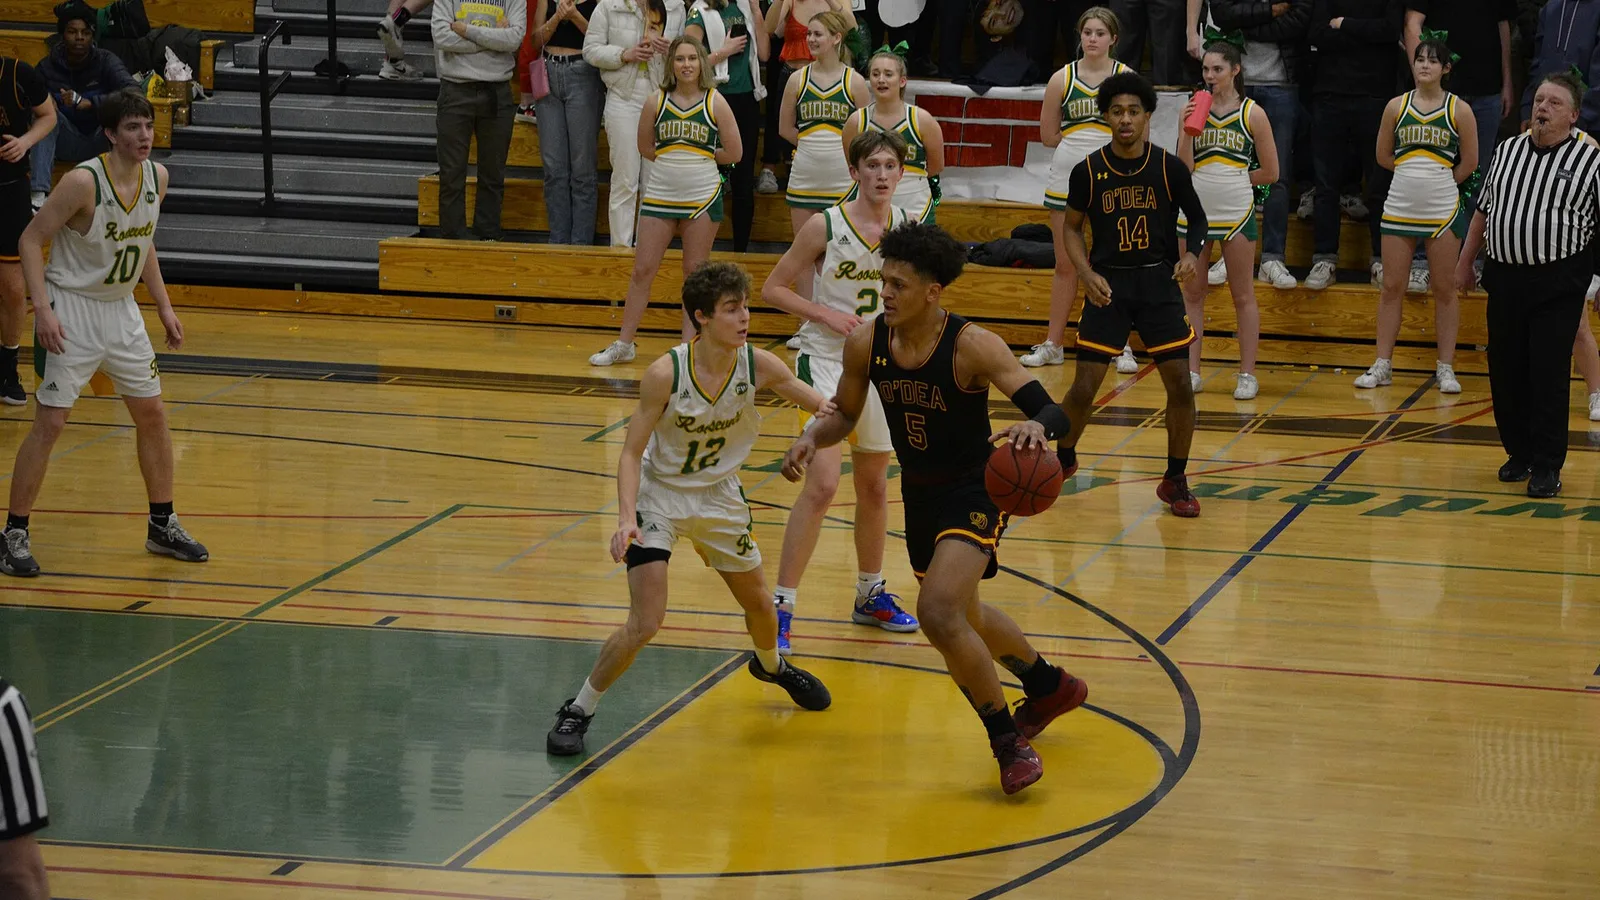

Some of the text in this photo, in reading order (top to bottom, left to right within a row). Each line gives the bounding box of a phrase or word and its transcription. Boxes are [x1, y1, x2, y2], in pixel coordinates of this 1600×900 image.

[800, 100, 850, 121] RIDERS
[1068, 97, 1101, 119] RIDE
[658, 119, 710, 144] RIDERS
[1194, 127, 1246, 152] RIDERS
[1398, 124, 1450, 148] RIDERS
[1102, 186, 1157, 214] O'DEA
[1117, 215, 1149, 252] 14
[103, 244, 140, 285] 10
[855, 288, 878, 317] 2
[879, 379, 947, 411] O'DEA
[904, 412, 928, 451] 5
[681, 437, 726, 474] 12
